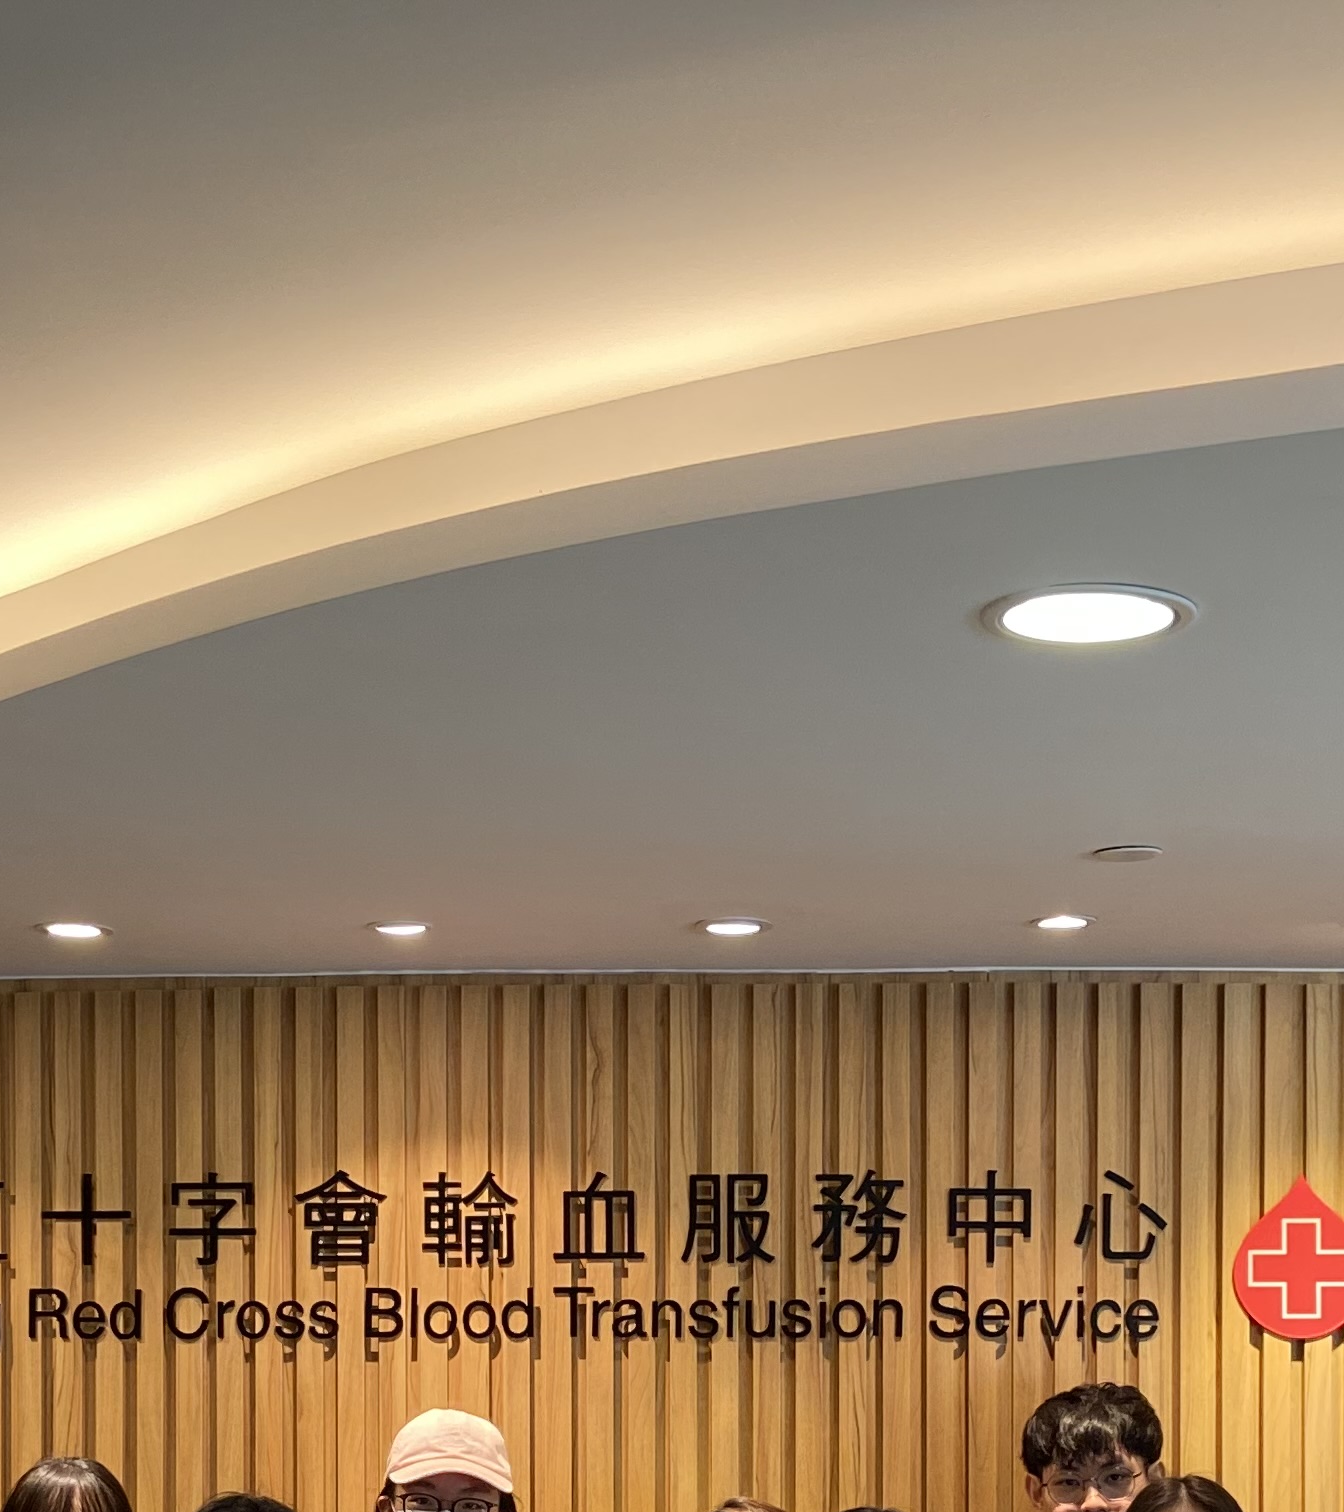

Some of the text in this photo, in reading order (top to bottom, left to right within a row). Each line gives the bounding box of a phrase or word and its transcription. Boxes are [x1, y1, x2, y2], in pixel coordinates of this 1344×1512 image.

[27, 1288, 143, 1342] Red
[165, 1287, 340, 1342] Cross
[364, 1286, 535, 1342] Blood
[552, 1286, 905, 1342] Transfusion
[927, 1284, 1160, 1343] Service
